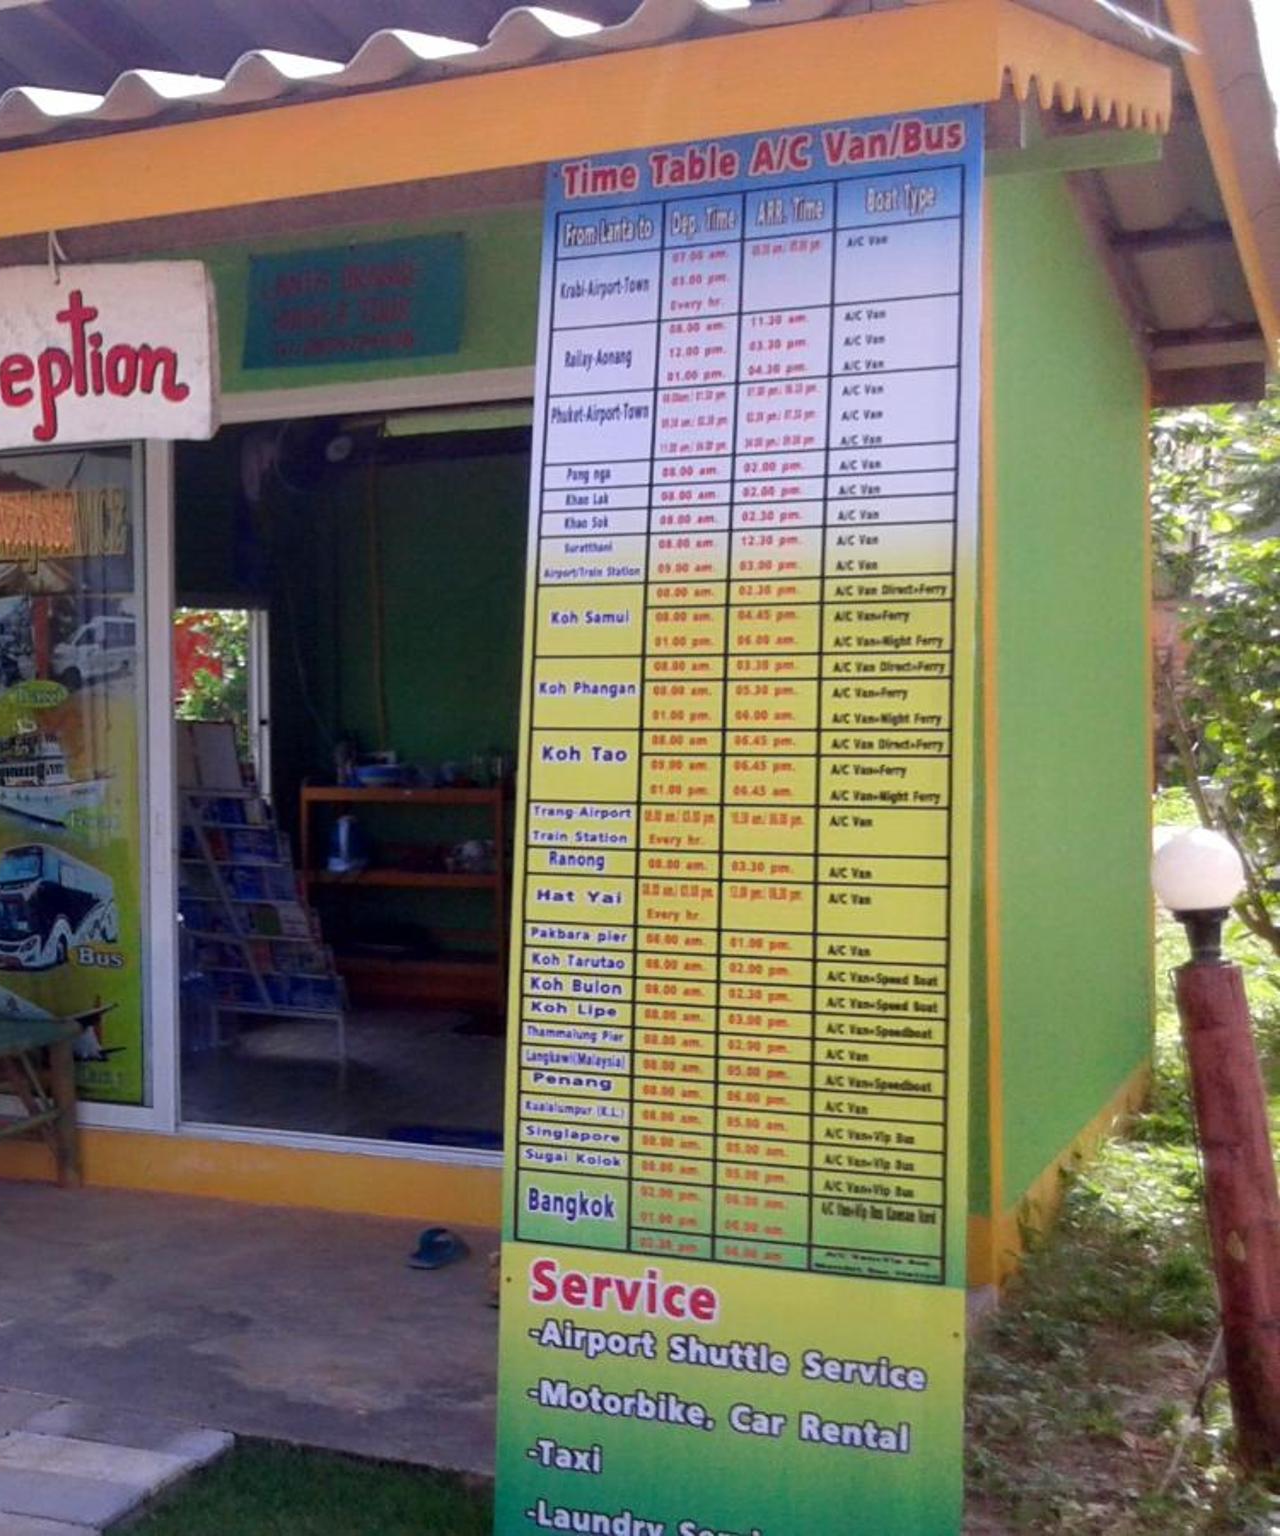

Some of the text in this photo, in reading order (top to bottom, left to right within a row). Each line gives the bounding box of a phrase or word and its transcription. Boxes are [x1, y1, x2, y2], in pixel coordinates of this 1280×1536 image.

[561, 119, 965, 198] Time Table A/C Van/Bus
[793, 196, 824, 221] Time
[866, 183, 935, 215] Boat Type
[705, 208, 736, 231] Time
[564, 217, 652, 247] From Lanta to
[607, 566, 640, 576] Station
[551, 609, 629, 625] Koh Samui
[539, 681, 636, 698] Koh Phangan
[542, 746, 627, 762] Koh Tao
[533, 830, 627, 844] Train Station
[549, 851, 605, 871] Ranong
[537, 890, 622, 904] Hat Yai
[531, 927, 628, 943] Pakbara pier
[79, 947, 124, 968] Bus
[532, 954, 625, 970] Koh Tarutao
[530, 977, 622, 995] Koh Bulon
[531, 1001, 617, 1019] Koh Lipe
[533, 1072, 612, 1091] Penang
[525, 1148, 568, 1163] Sugai
[528, 1187, 615, 1221] Bangkok
[530, 1259, 718, 1321] Service
[528, 1319, 927, 1391] -Airport Shuttle Service
[728, 1405, 786, 1437] Car
[800, 1412, 910, 1454] Rental
[528, 1440, 603, 1475] -Taxi
